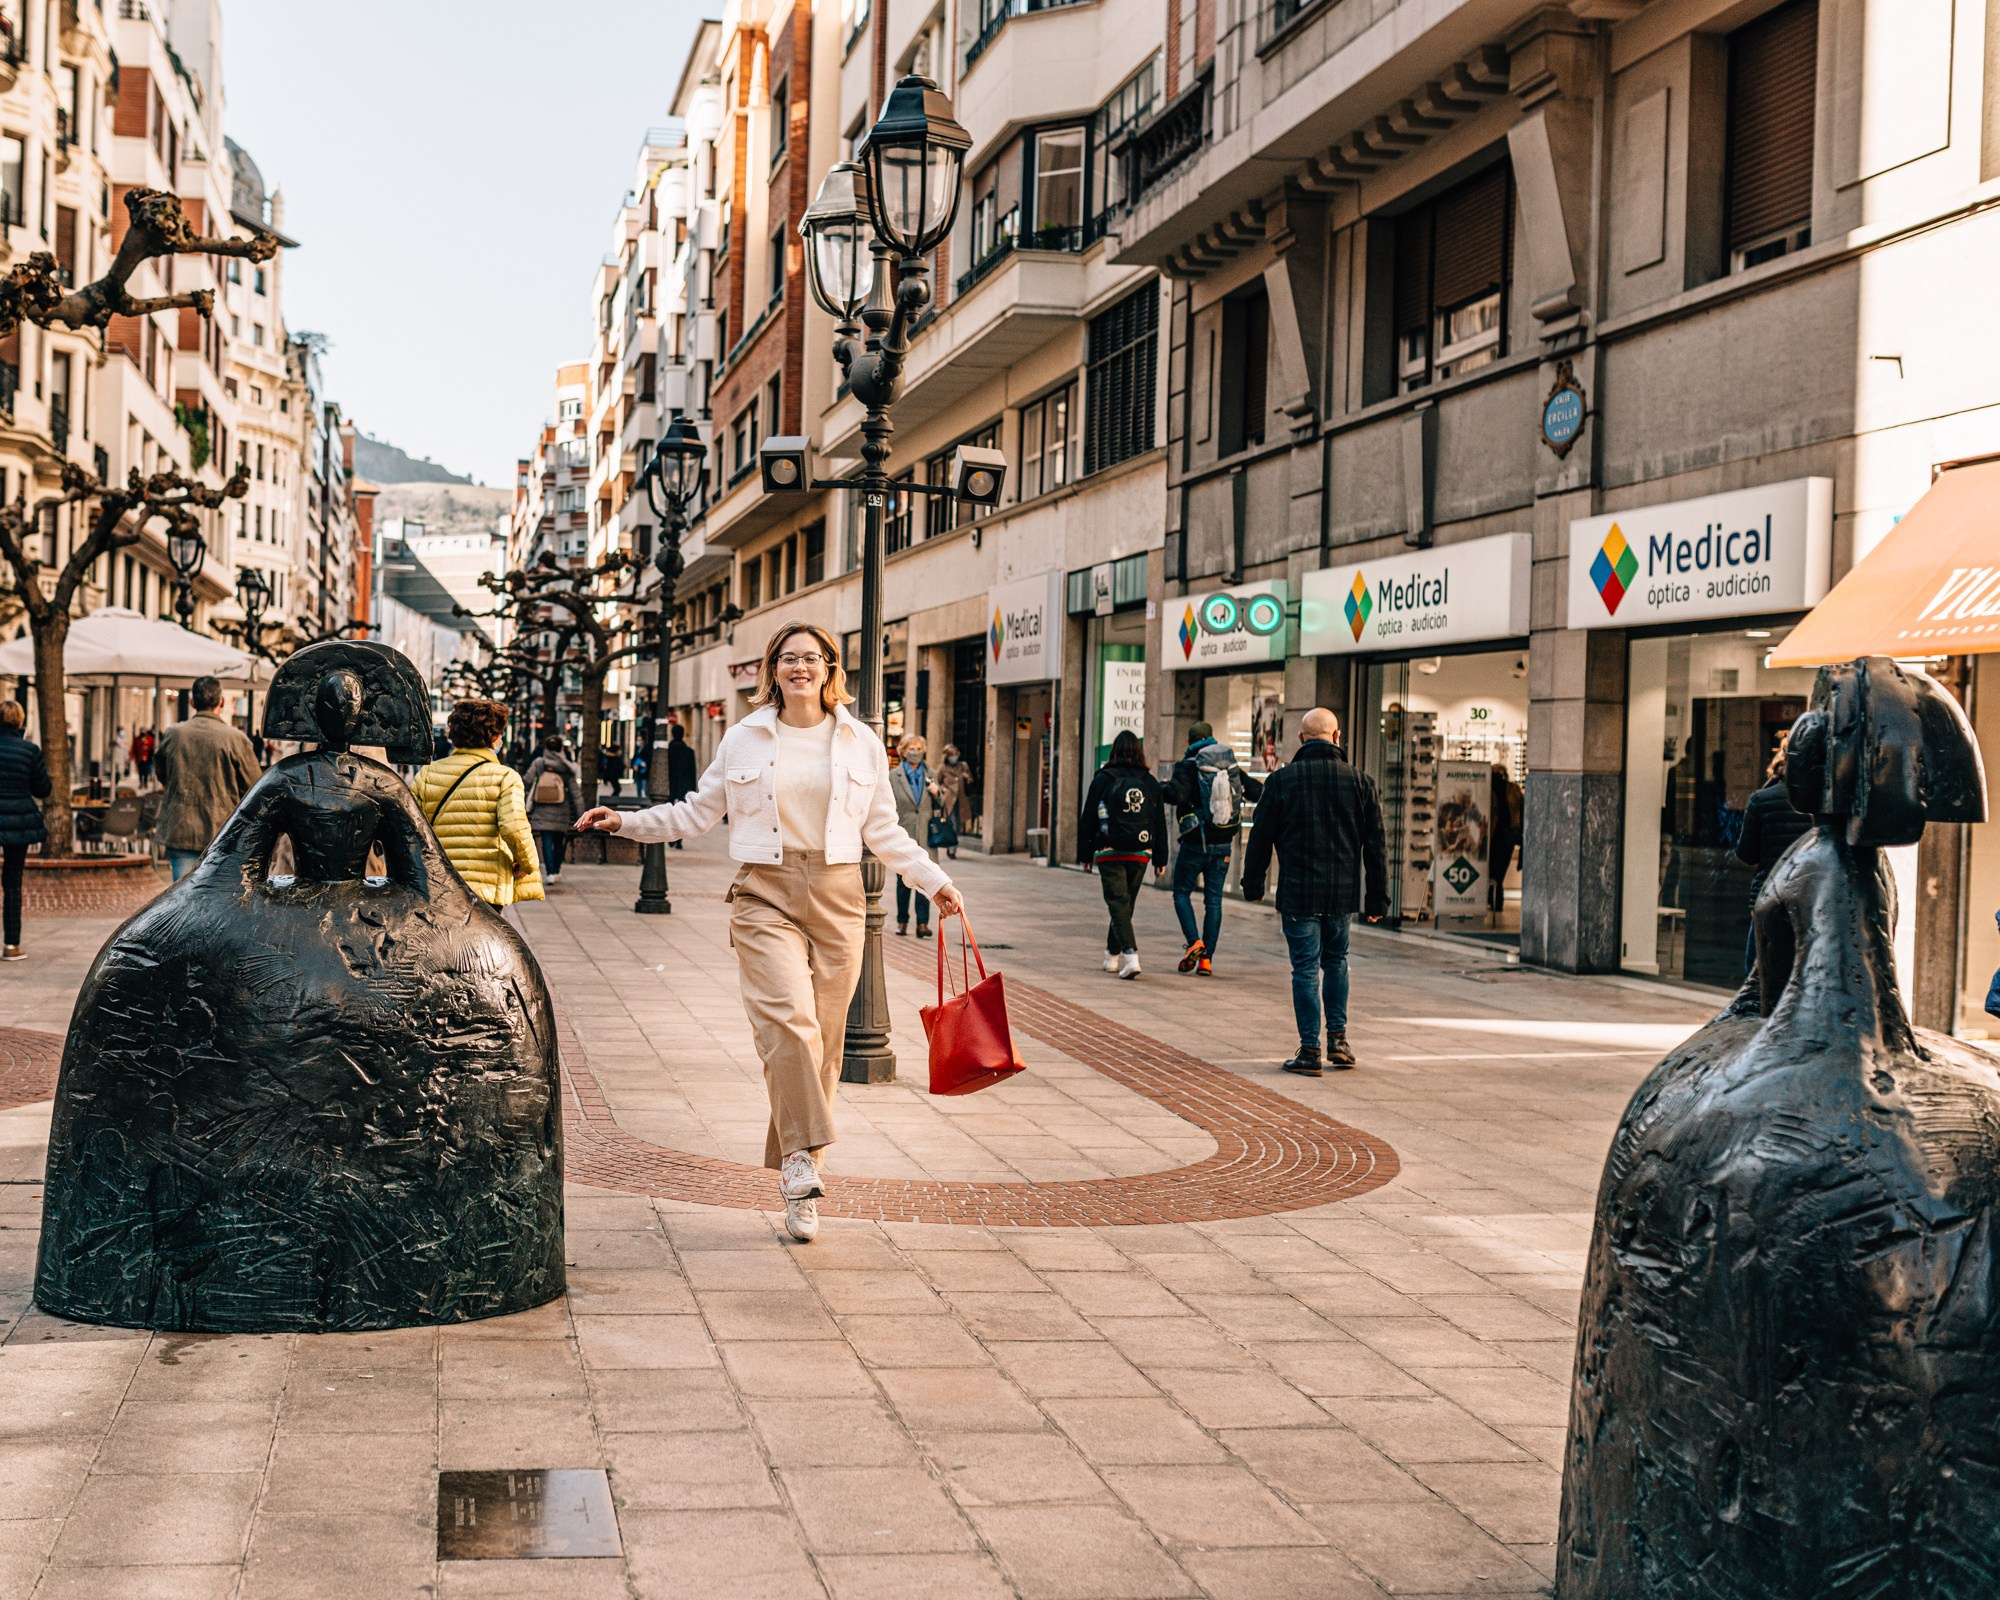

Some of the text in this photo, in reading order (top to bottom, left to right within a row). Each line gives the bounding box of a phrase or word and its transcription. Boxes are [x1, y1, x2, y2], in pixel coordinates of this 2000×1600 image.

[1547, 406, 1578, 425] ERCILLA
[868, 495, 882, 505] 49
[1648, 513, 1772, 577] Medical
[1378, 567, 1448, 613] Medical
[1648, 571, 1771, 610] óptica audición
[1006, 604, 1043, 641] Medical
[1377, 611, 1448, 639] óptica audición
